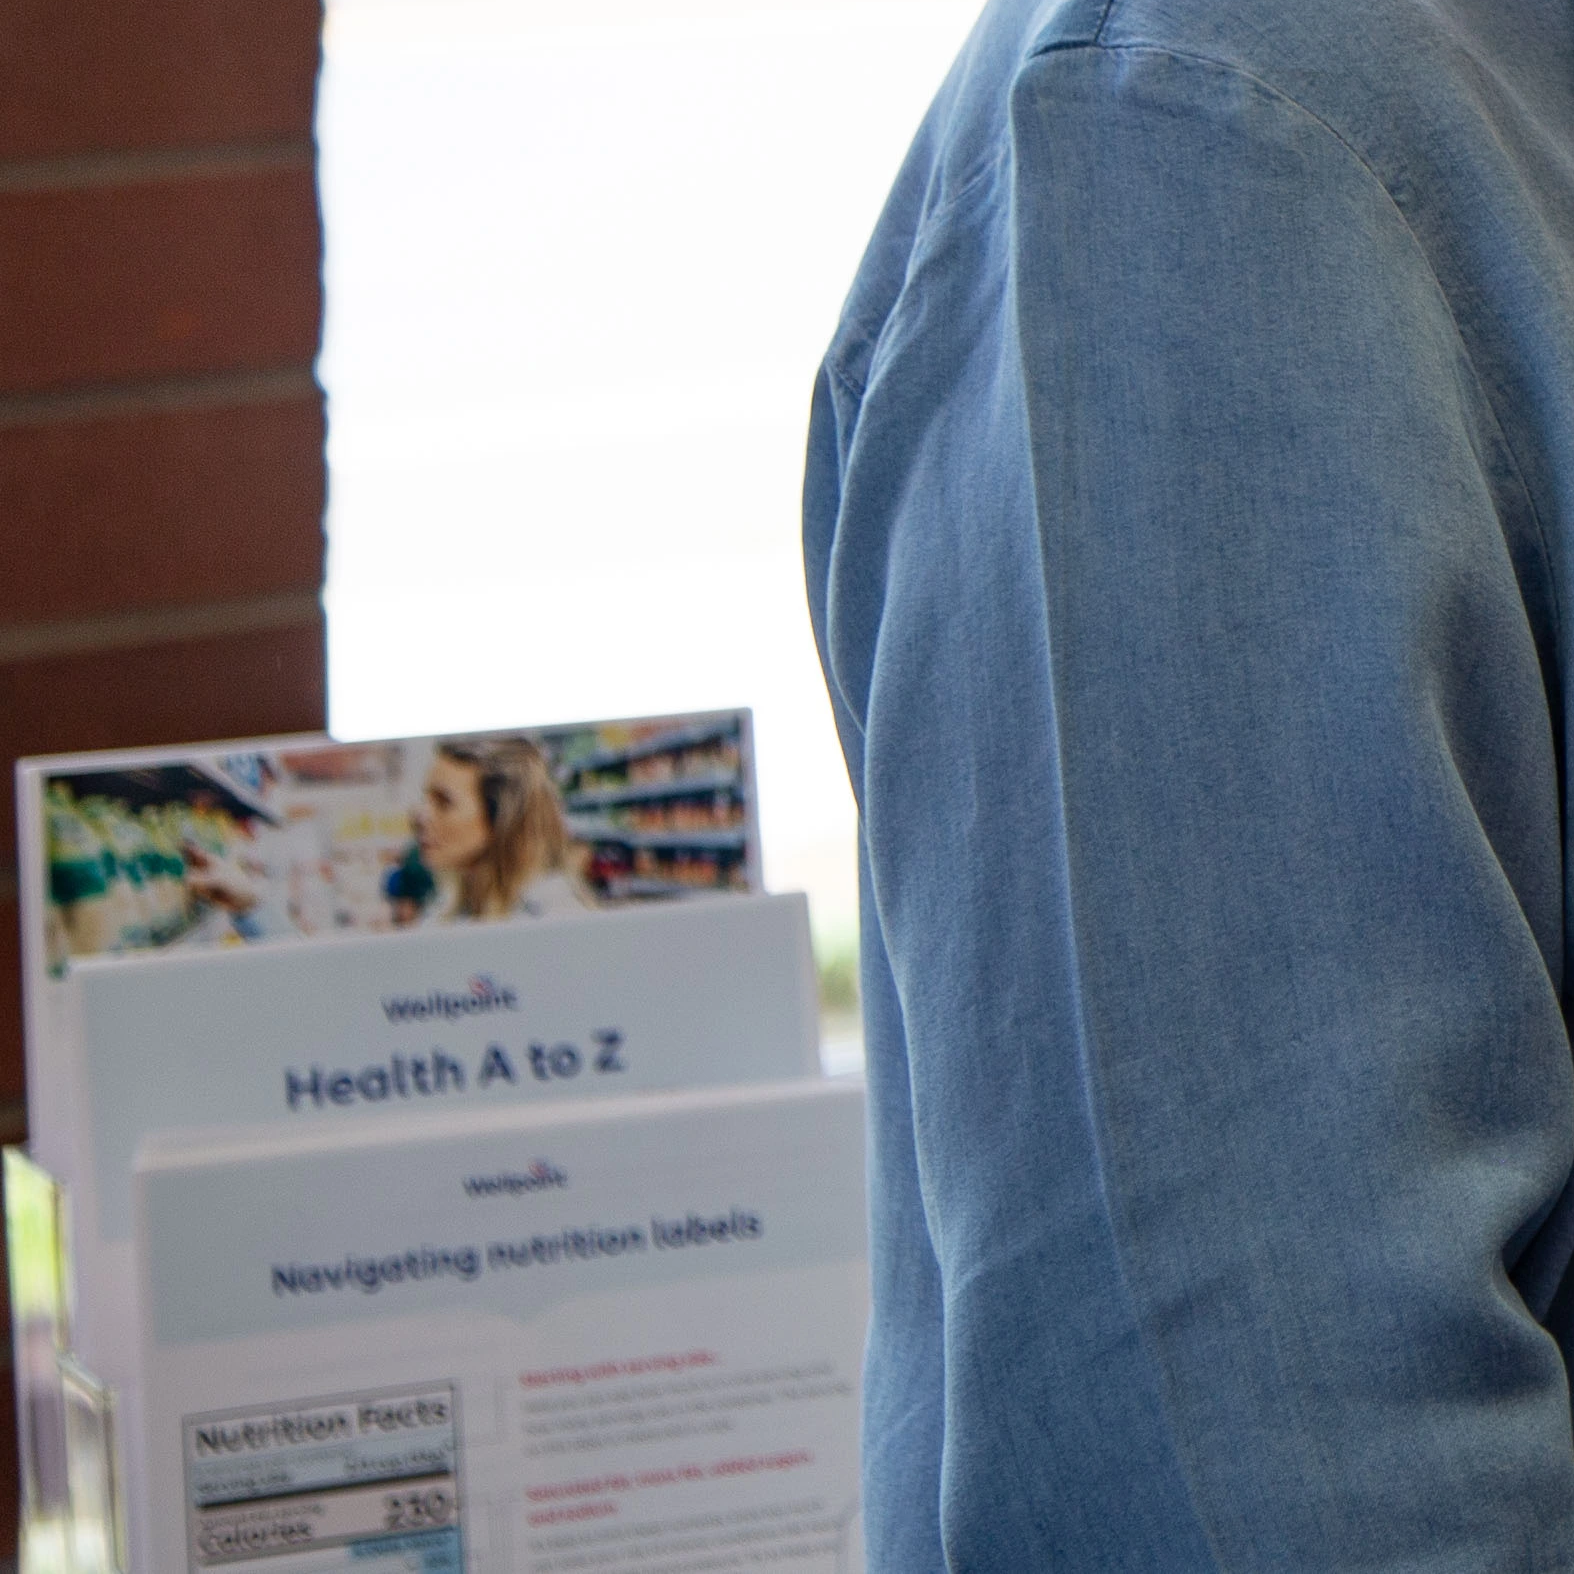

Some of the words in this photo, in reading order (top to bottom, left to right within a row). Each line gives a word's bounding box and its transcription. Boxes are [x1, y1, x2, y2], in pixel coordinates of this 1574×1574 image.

[284, 1043, 466, 1111] Health
[478, 1042, 517, 1085] A
[528, 1040, 583, 1082] to
[591, 1027, 627, 1074] Z
[272, 1243, 481, 1296] Navigating
[487, 1224, 647, 1272] nutrition
[650, 1206, 764, 1251] labels
[197, 1413, 349, 1457] Nutrition
